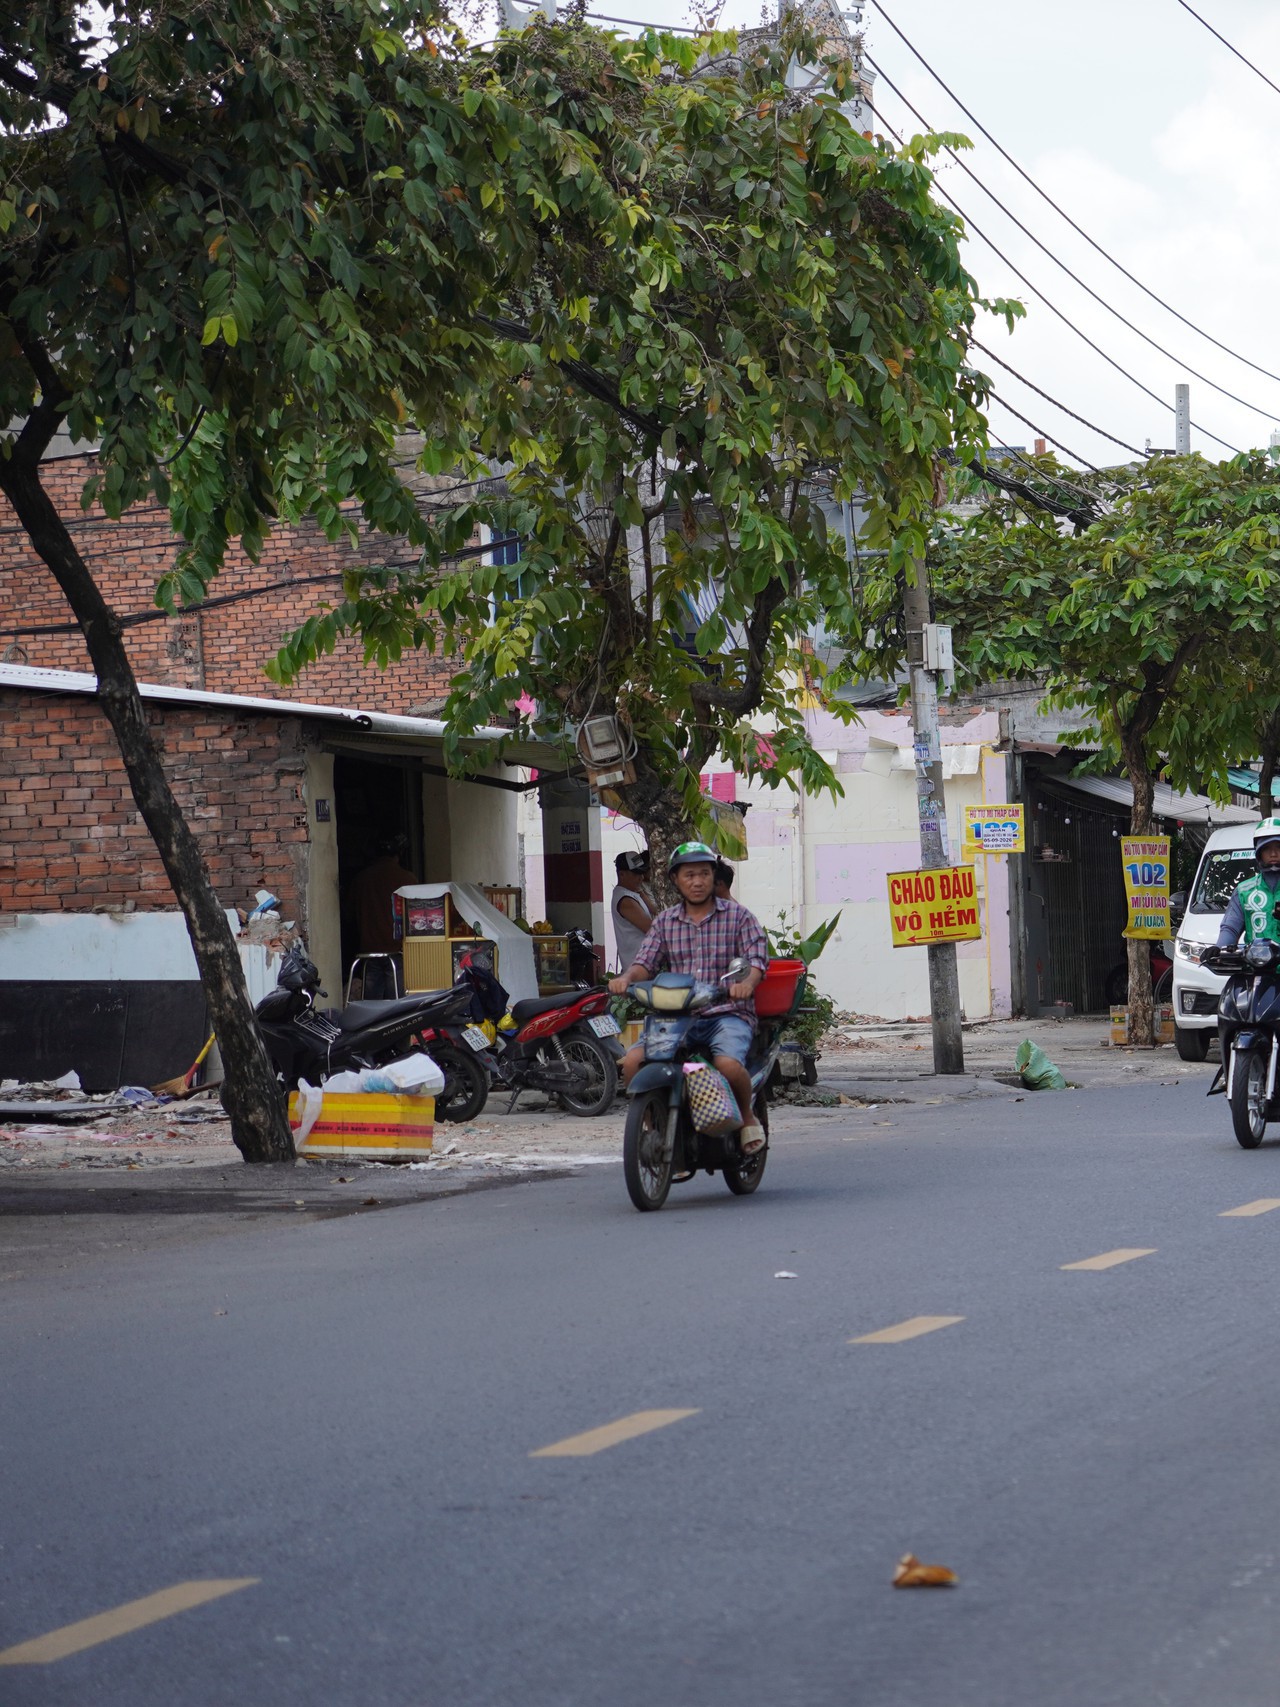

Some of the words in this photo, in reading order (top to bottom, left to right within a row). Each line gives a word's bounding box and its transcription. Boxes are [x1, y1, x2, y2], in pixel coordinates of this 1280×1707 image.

[891, 871, 935, 905] CHÁO
[940, 867, 974, 905] ĐẬU
[1126, 863, 1166, 886] 102
[894, 911, 922, 932] VÔ
[929, 905, 976, 929] HẺM
